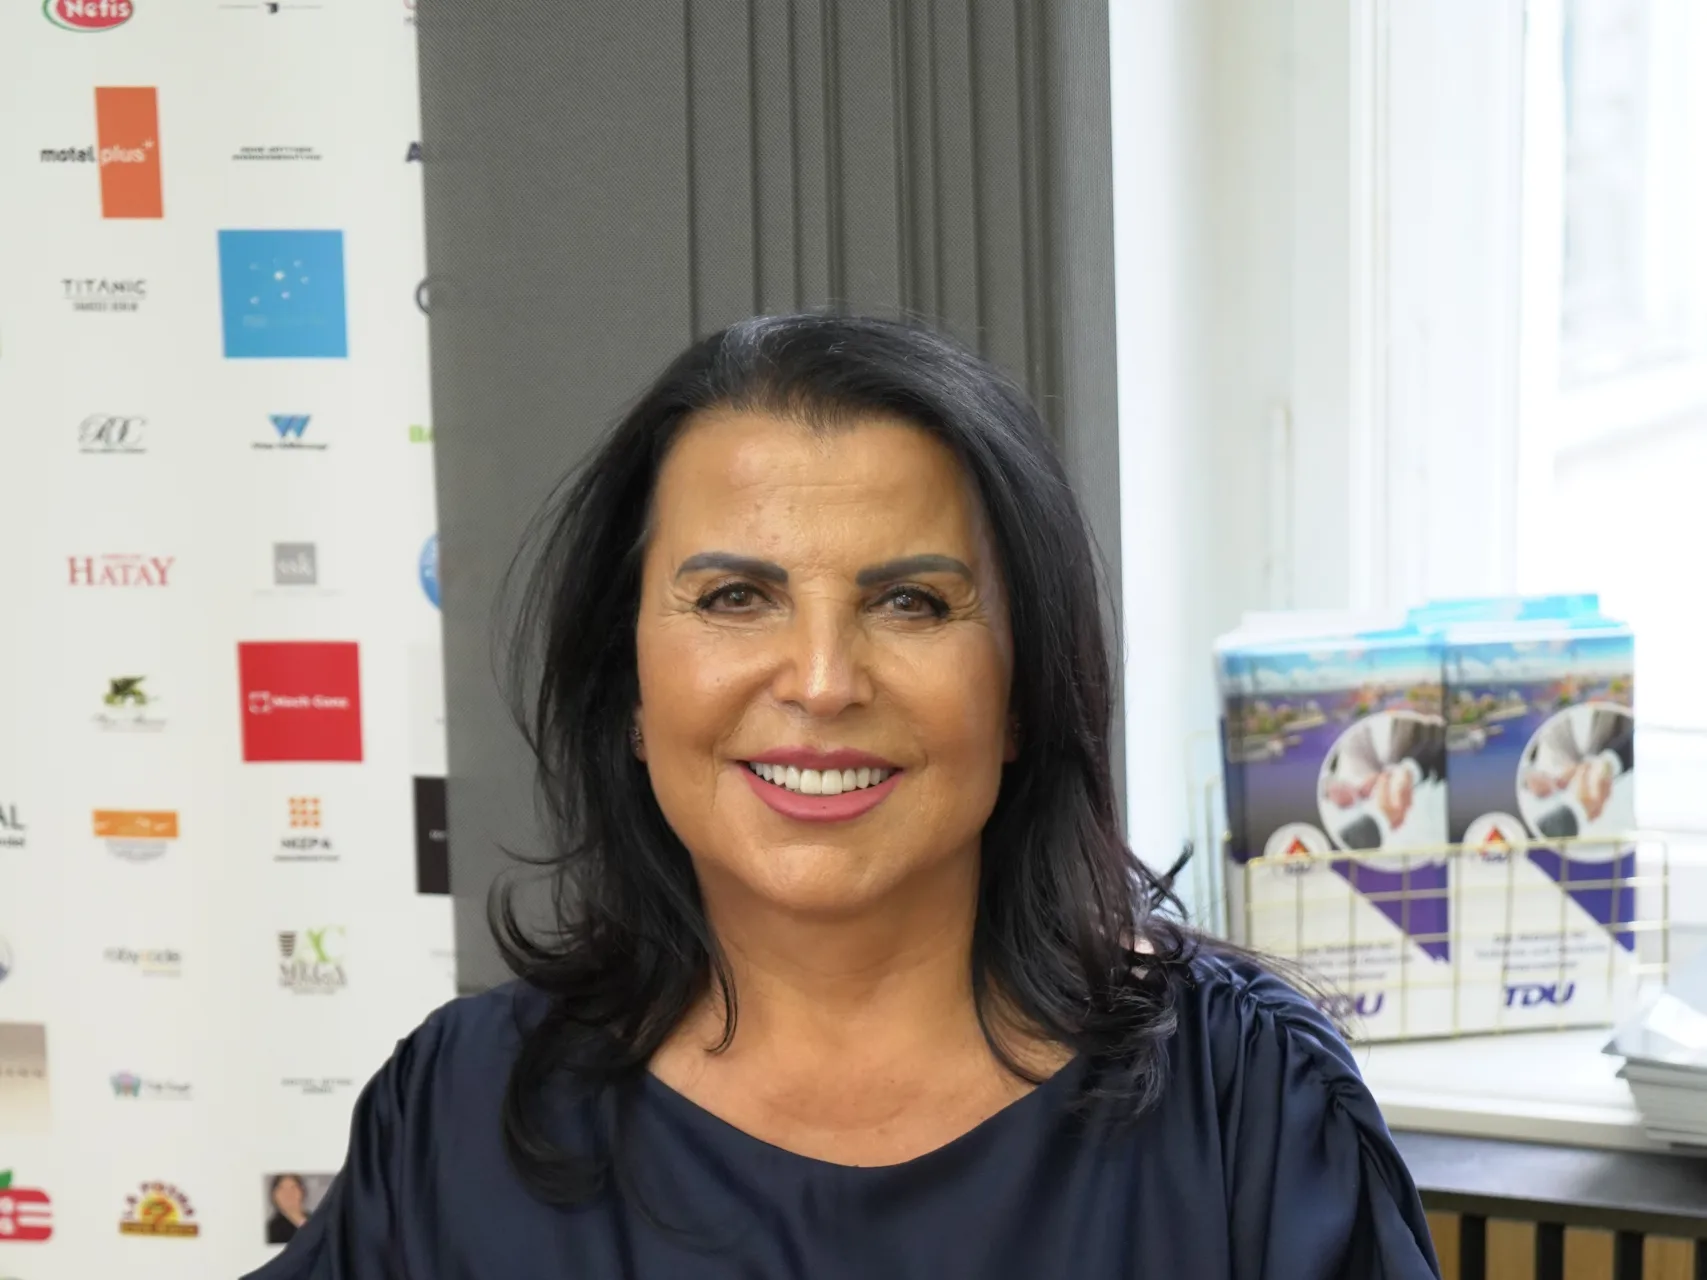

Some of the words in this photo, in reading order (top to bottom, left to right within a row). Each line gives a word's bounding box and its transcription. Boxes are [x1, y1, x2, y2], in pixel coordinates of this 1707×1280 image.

[60, 278, 147, 296] TITANIC
[66, 554, 176, 587] HATAY
[1504, 982, 1574, 1006] TDU
